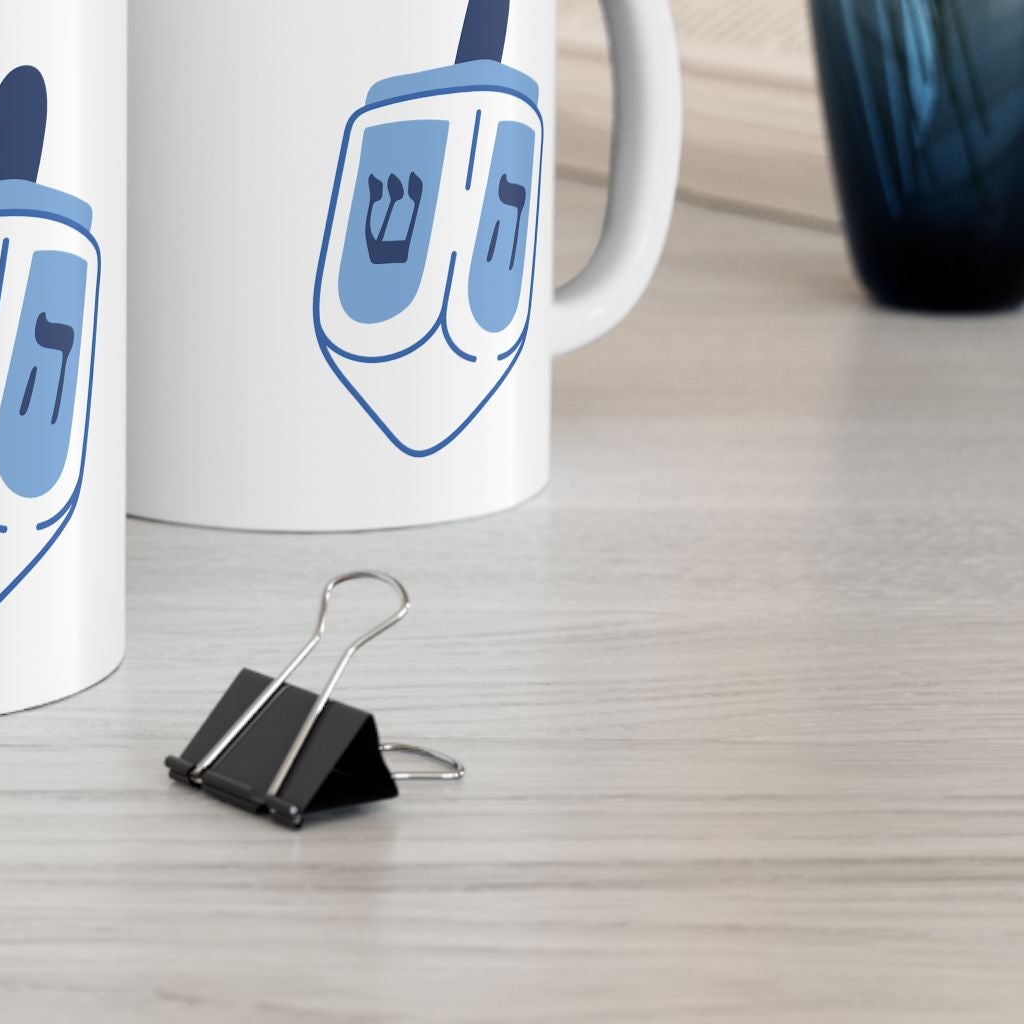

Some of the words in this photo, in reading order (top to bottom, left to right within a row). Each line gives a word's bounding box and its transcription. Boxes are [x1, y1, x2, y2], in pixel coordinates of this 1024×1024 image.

[365, 171, 423, 264] ש
[486, 173, 526, 270] ה
[19, 312, 74, 425] ה
